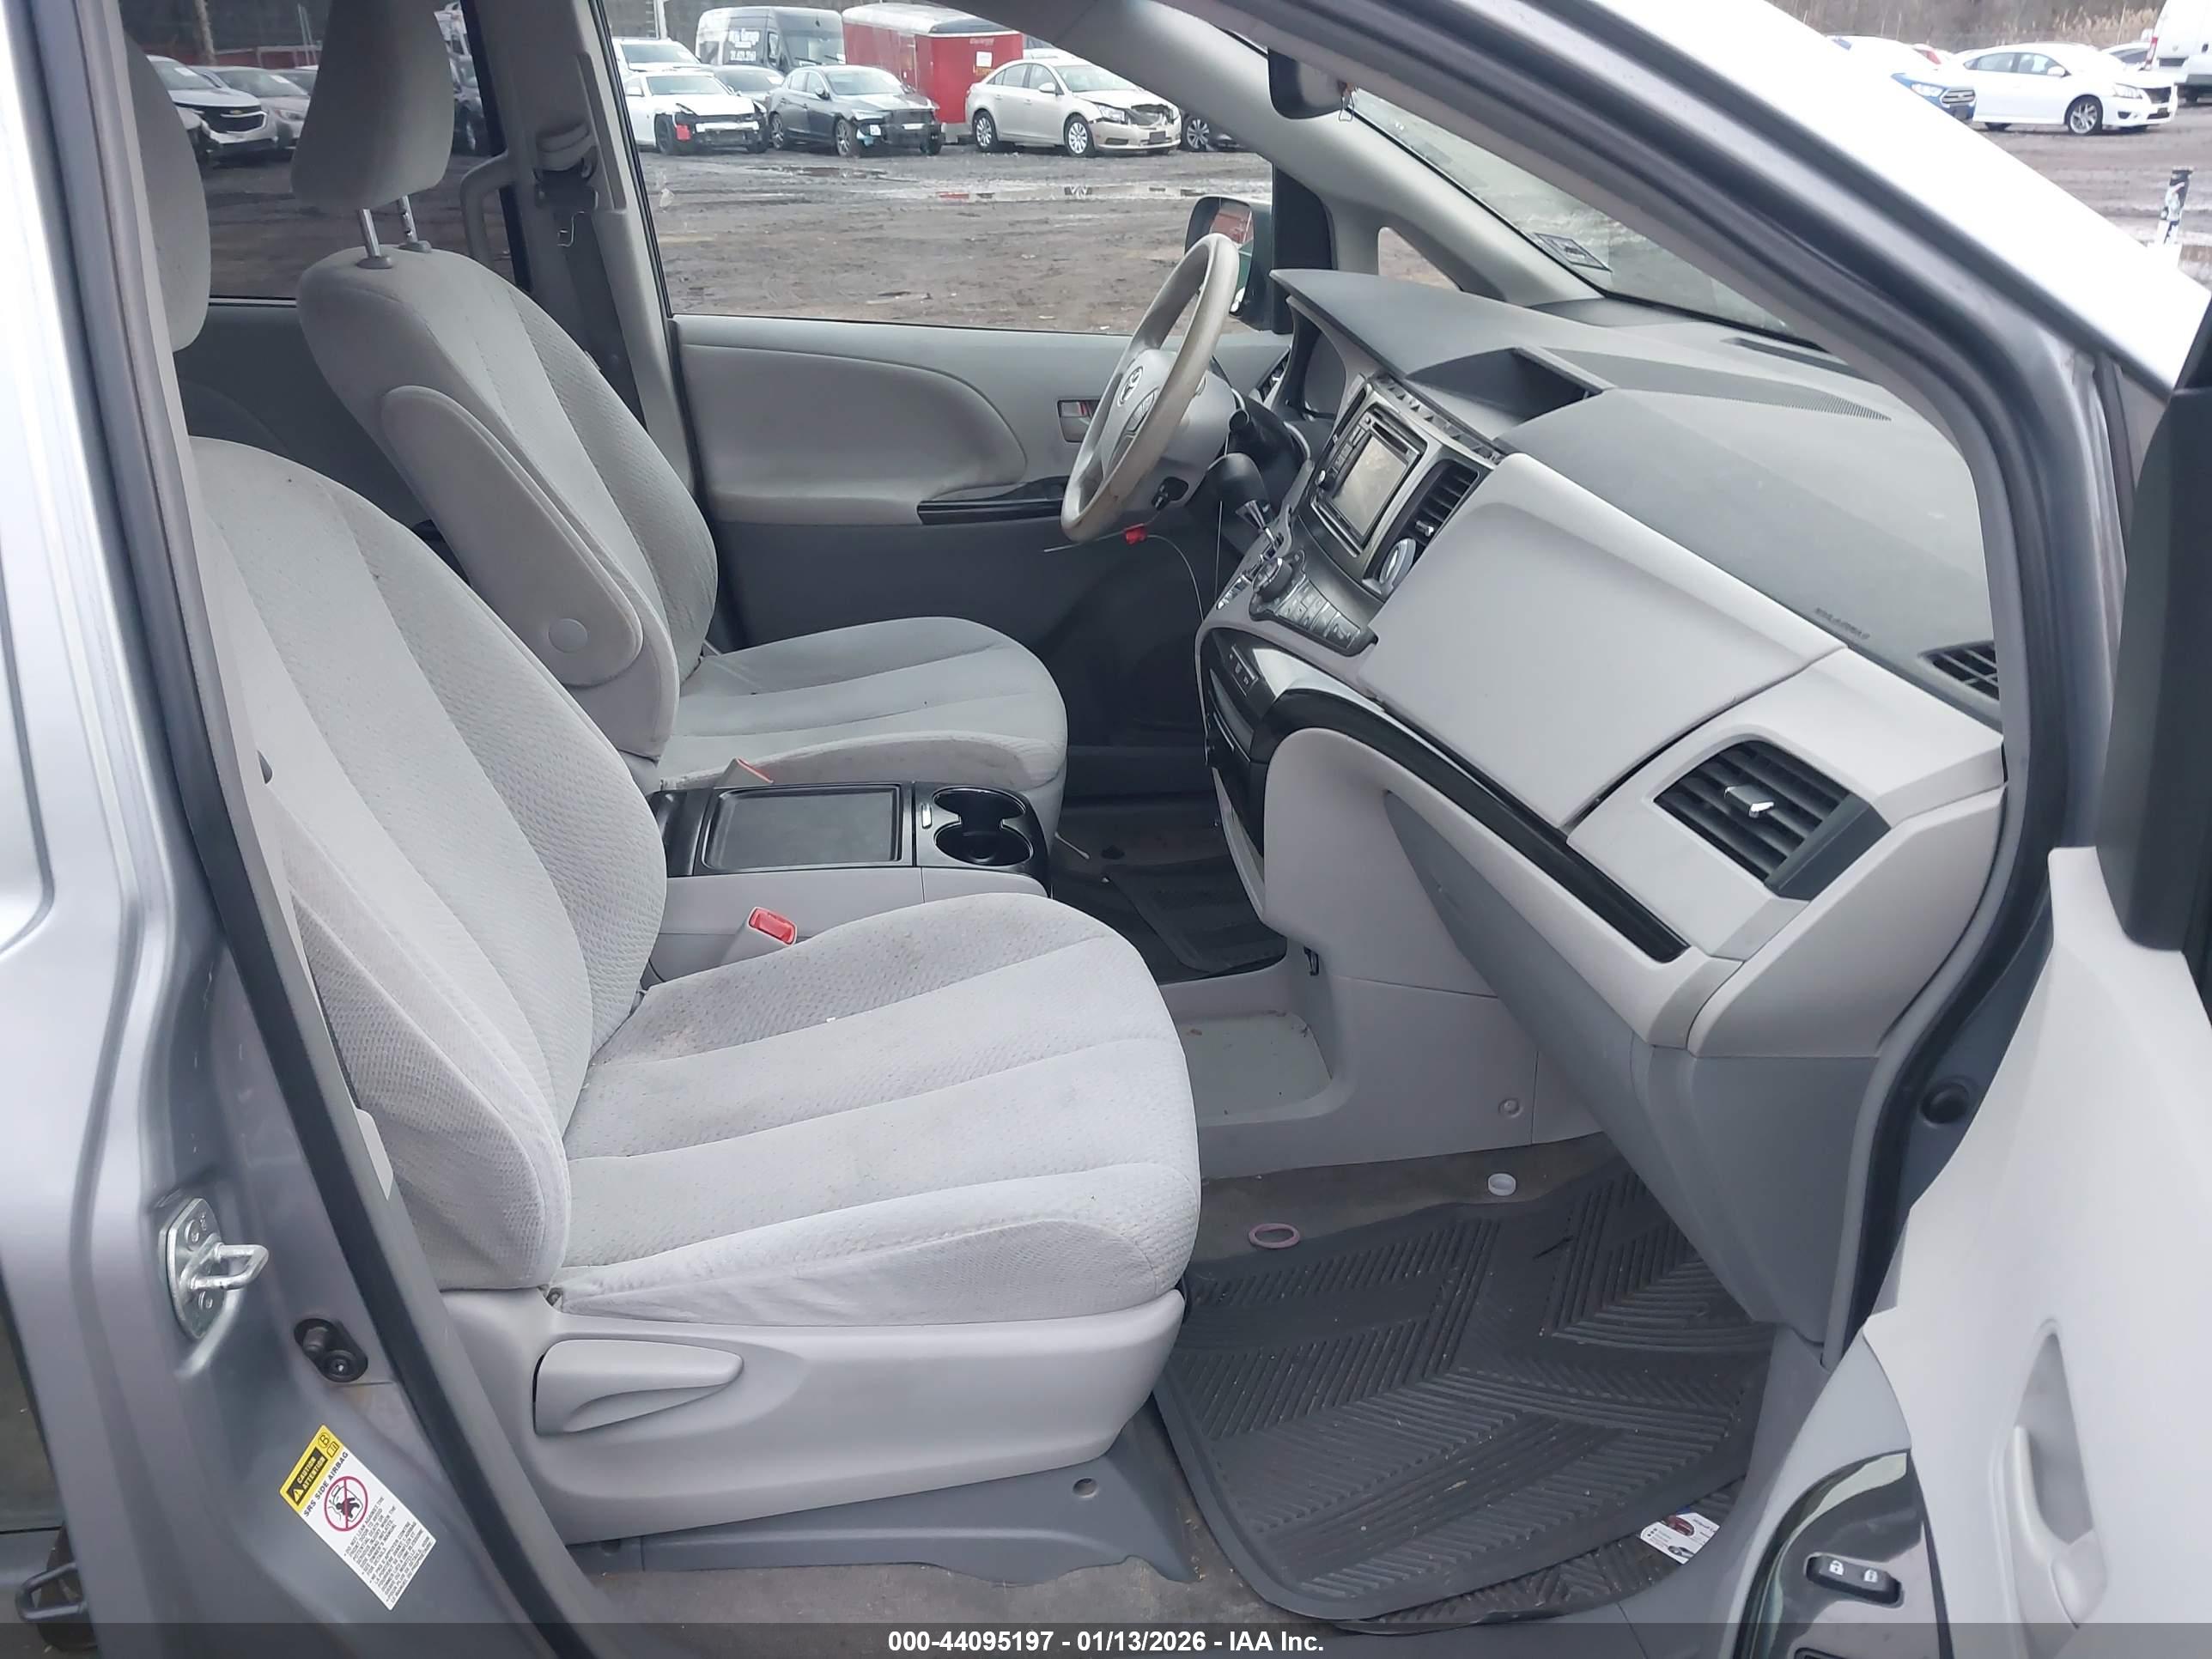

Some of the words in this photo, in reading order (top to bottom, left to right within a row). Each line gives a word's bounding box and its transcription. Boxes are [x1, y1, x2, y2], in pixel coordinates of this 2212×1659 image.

[296, 1455, 316, 1485] CAUTION
[302, 1455, 327, 1490] ATTENTION
[303, 1498, 316, 1517] SRS
[314, 1480, 328, 1500] SIDE
[326, 1450, 348, 1481] AIRBAG
